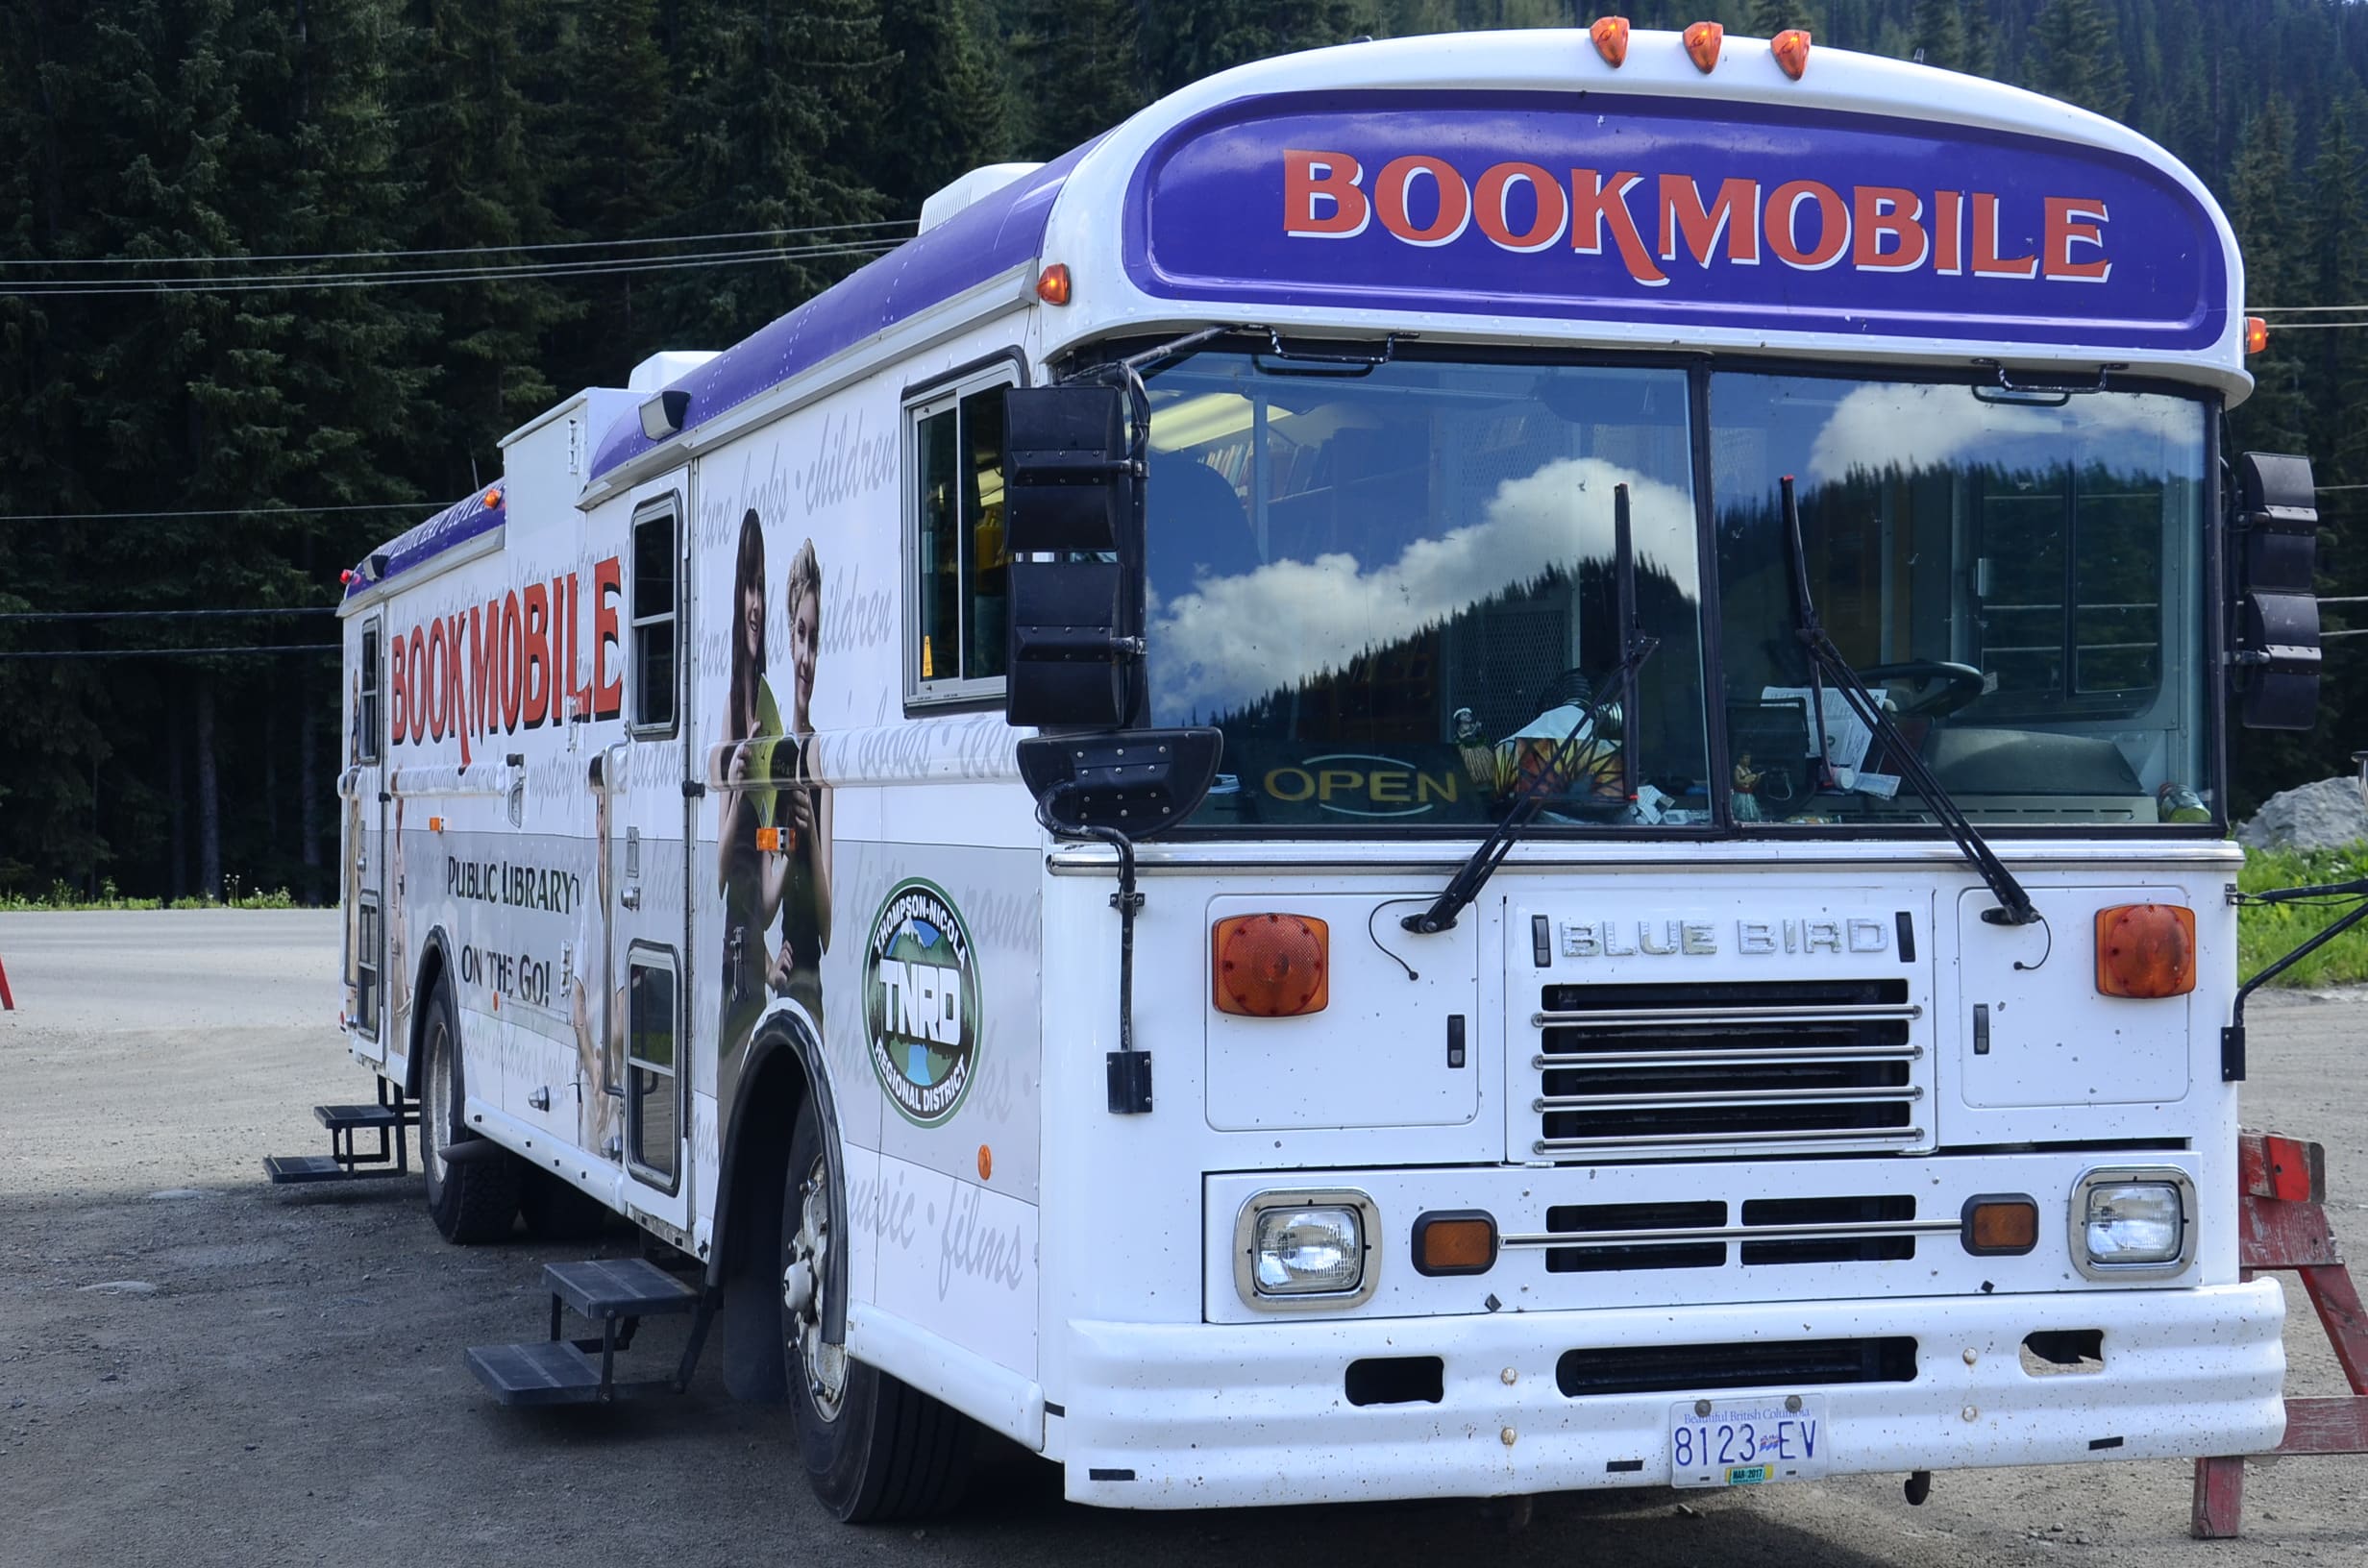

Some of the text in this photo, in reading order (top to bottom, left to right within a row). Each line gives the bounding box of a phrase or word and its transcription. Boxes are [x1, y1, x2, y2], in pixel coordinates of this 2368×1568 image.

[1283, 149, 2111, 286] BOOKMOBILE
[805, 407, 898, 516] children
[391, 555, 623, 775] BOOKMOBILE
[1264, 768, 1458, 803] OPEN
[448, 855, 572, 915] PUBLIC LIBRARY
[874, 894, 967, 970] THOMPSON-NICOLA
[1560, 918, 1889, 957] BLUE BIRD
[461, 944, 551, 1008] ON THE GO!
[879, 959, 961, 1046] TNRD
[875, 1036, 922, 1112] REGIONAL
[924, 1053, 967, 1112] DISTRICT
[938, 1167, 1024, 1303] films
[1674, 1420, 1816, 1466] 8123 EV
[1684, 1408, 1811, 1424] Beautiful British Columbia
[1747, 1468, 1764, 1479] 2017
